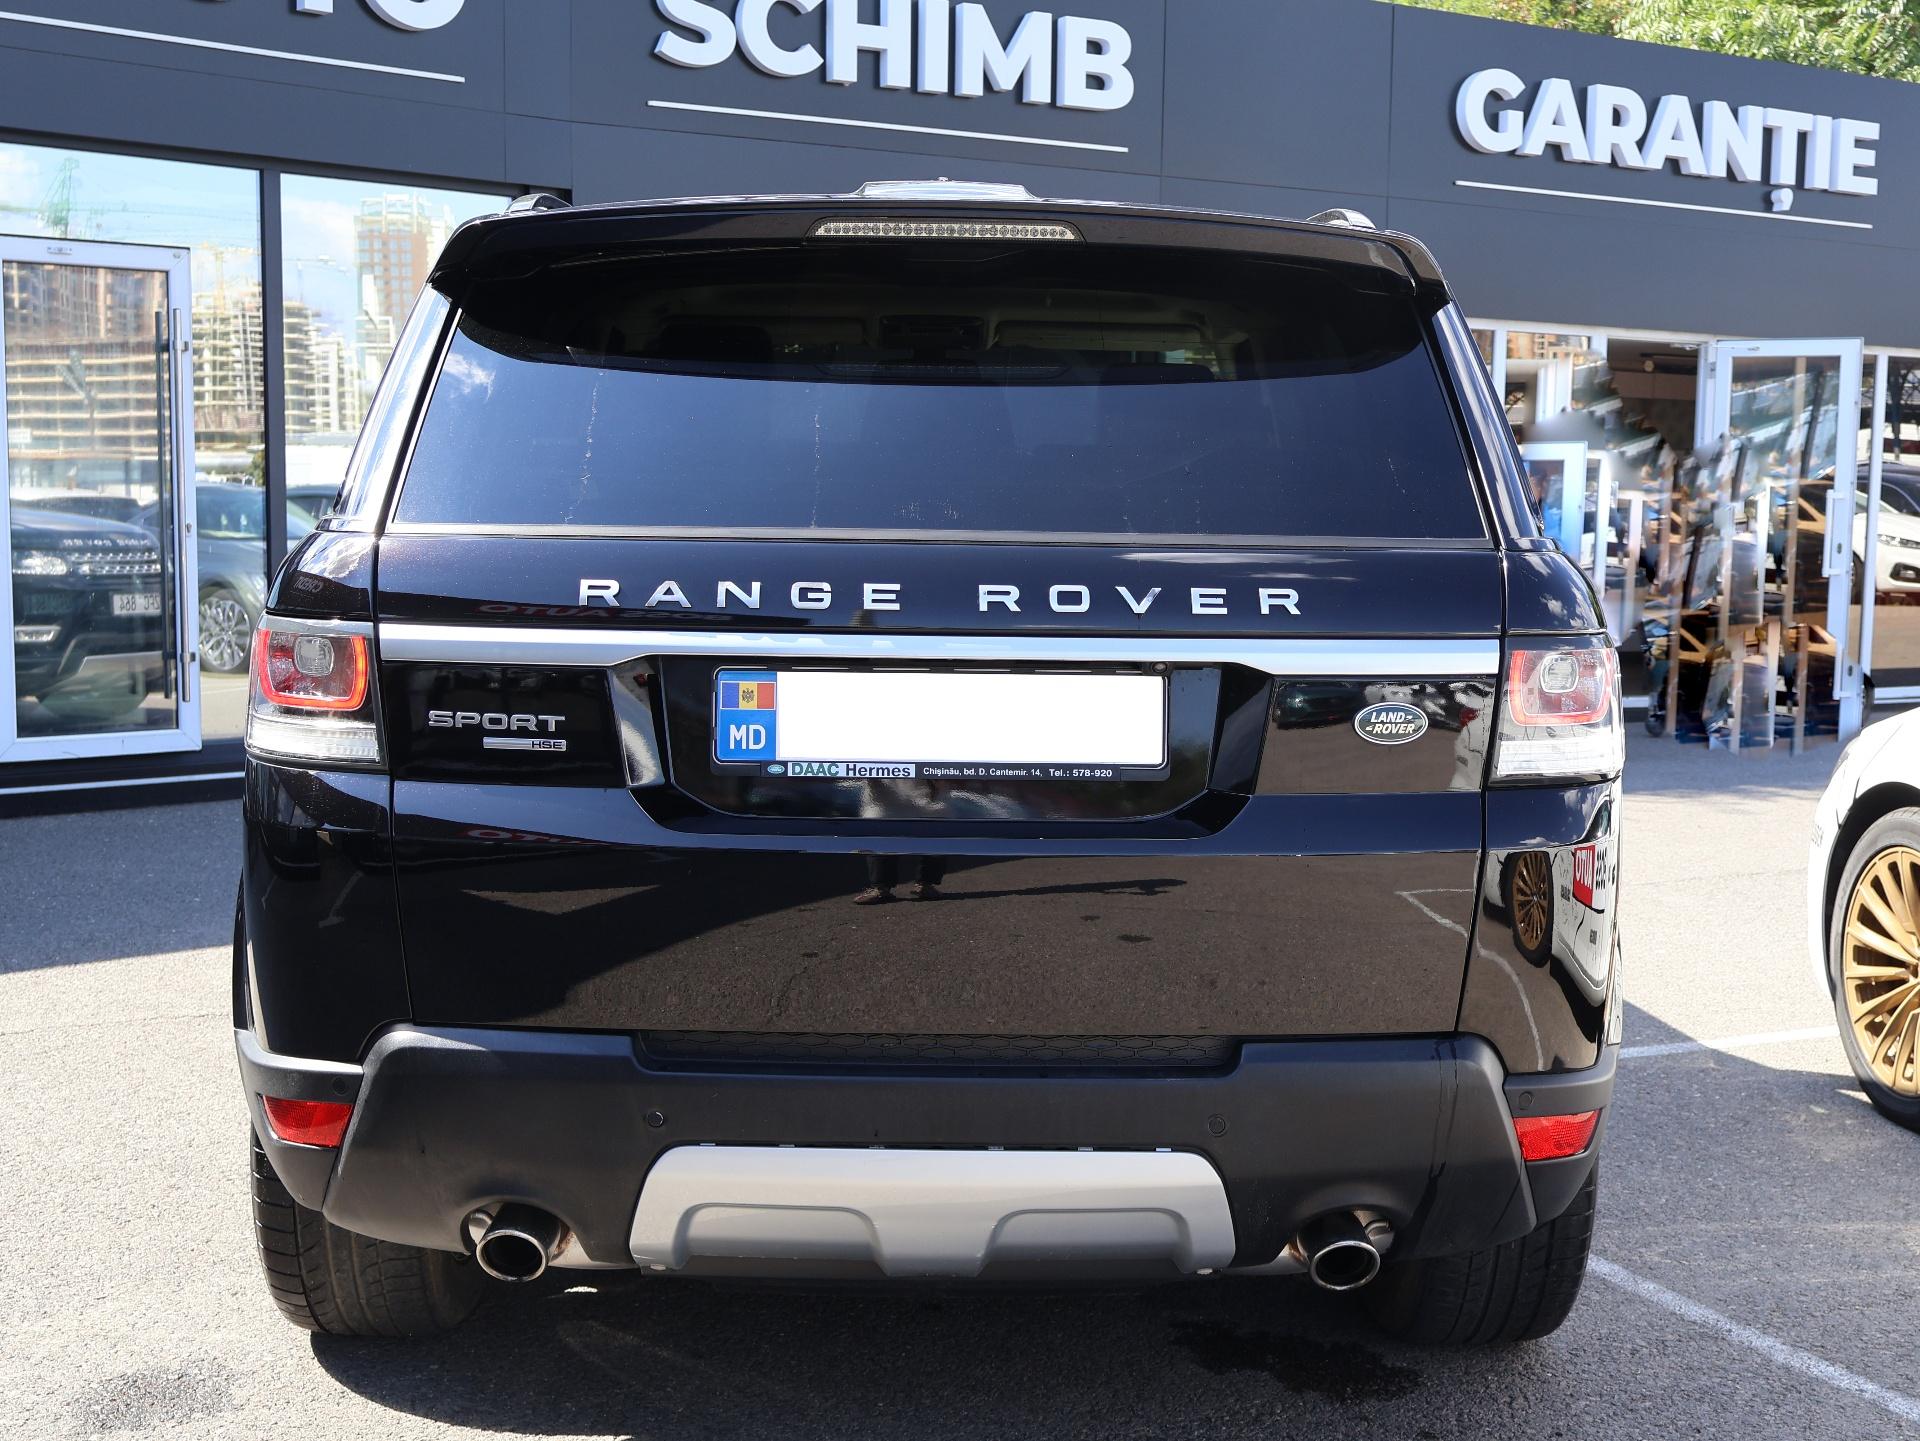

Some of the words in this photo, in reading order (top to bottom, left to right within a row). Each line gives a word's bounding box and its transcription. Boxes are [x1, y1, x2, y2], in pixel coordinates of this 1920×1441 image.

[653, 0, 1134, 111] SCHIMB
[1455, 68, 1881, 211] GARANȚIE
[578, 578, 901, 611] RANGE
[978, 584, 1301, 614] ROVER
[428, 710, 566, 732] SPORT
[1370, 711, 1406, 723] LAND
[729, 724, 766, 750] MD
[1372, 723, 1415, 734] ROVER
[531, 740, 563, 749] HSE
[791, 762, 839, 776] DAAC
[846, 763, 911, 777] Hermes
[963, 767, 976, 775] bd.
[979, 767, 988, 776] D.
[989, 768, 1028, 776] Cantemir.
[1072, 769, 1113, 777] 578-920
